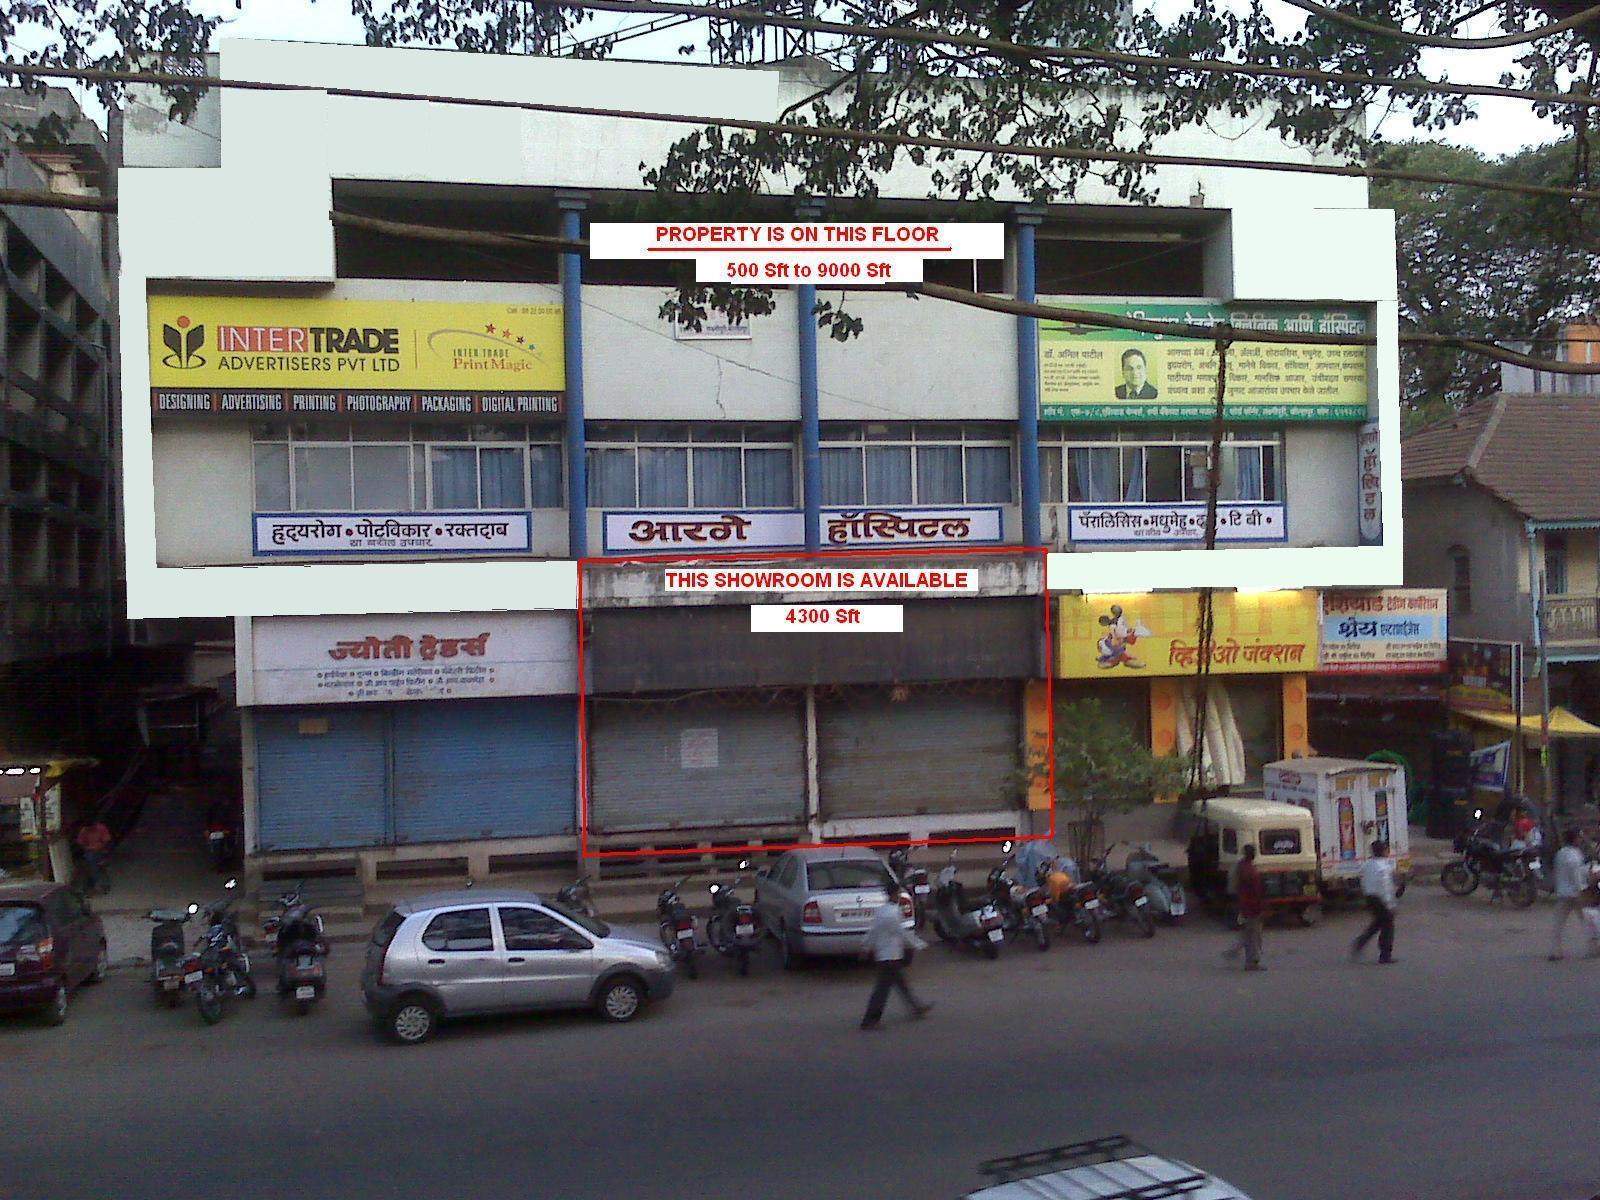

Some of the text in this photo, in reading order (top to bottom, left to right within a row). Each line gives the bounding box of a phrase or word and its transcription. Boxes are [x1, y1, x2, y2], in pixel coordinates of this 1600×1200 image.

[218, 326, 399, 354] INTER TRADE
[218, 356, 400, 372] ADVERTISERS PVT LTD
[483, 349, 509, 358] TRADE
[453, 358, 533, 372] Print Magic
[159, 393, 558, 412] DESIGNING ADVERTISING PRINTING PHOTOGRAPHY PACKAGING DIGITAL PRINTING
[272, 519, 343, 545] हृदयरोग
[827, 511, 971, 545] हॉस्पिटल
[328, 632, 491, 661] ज्योती ट्रेडर्स
